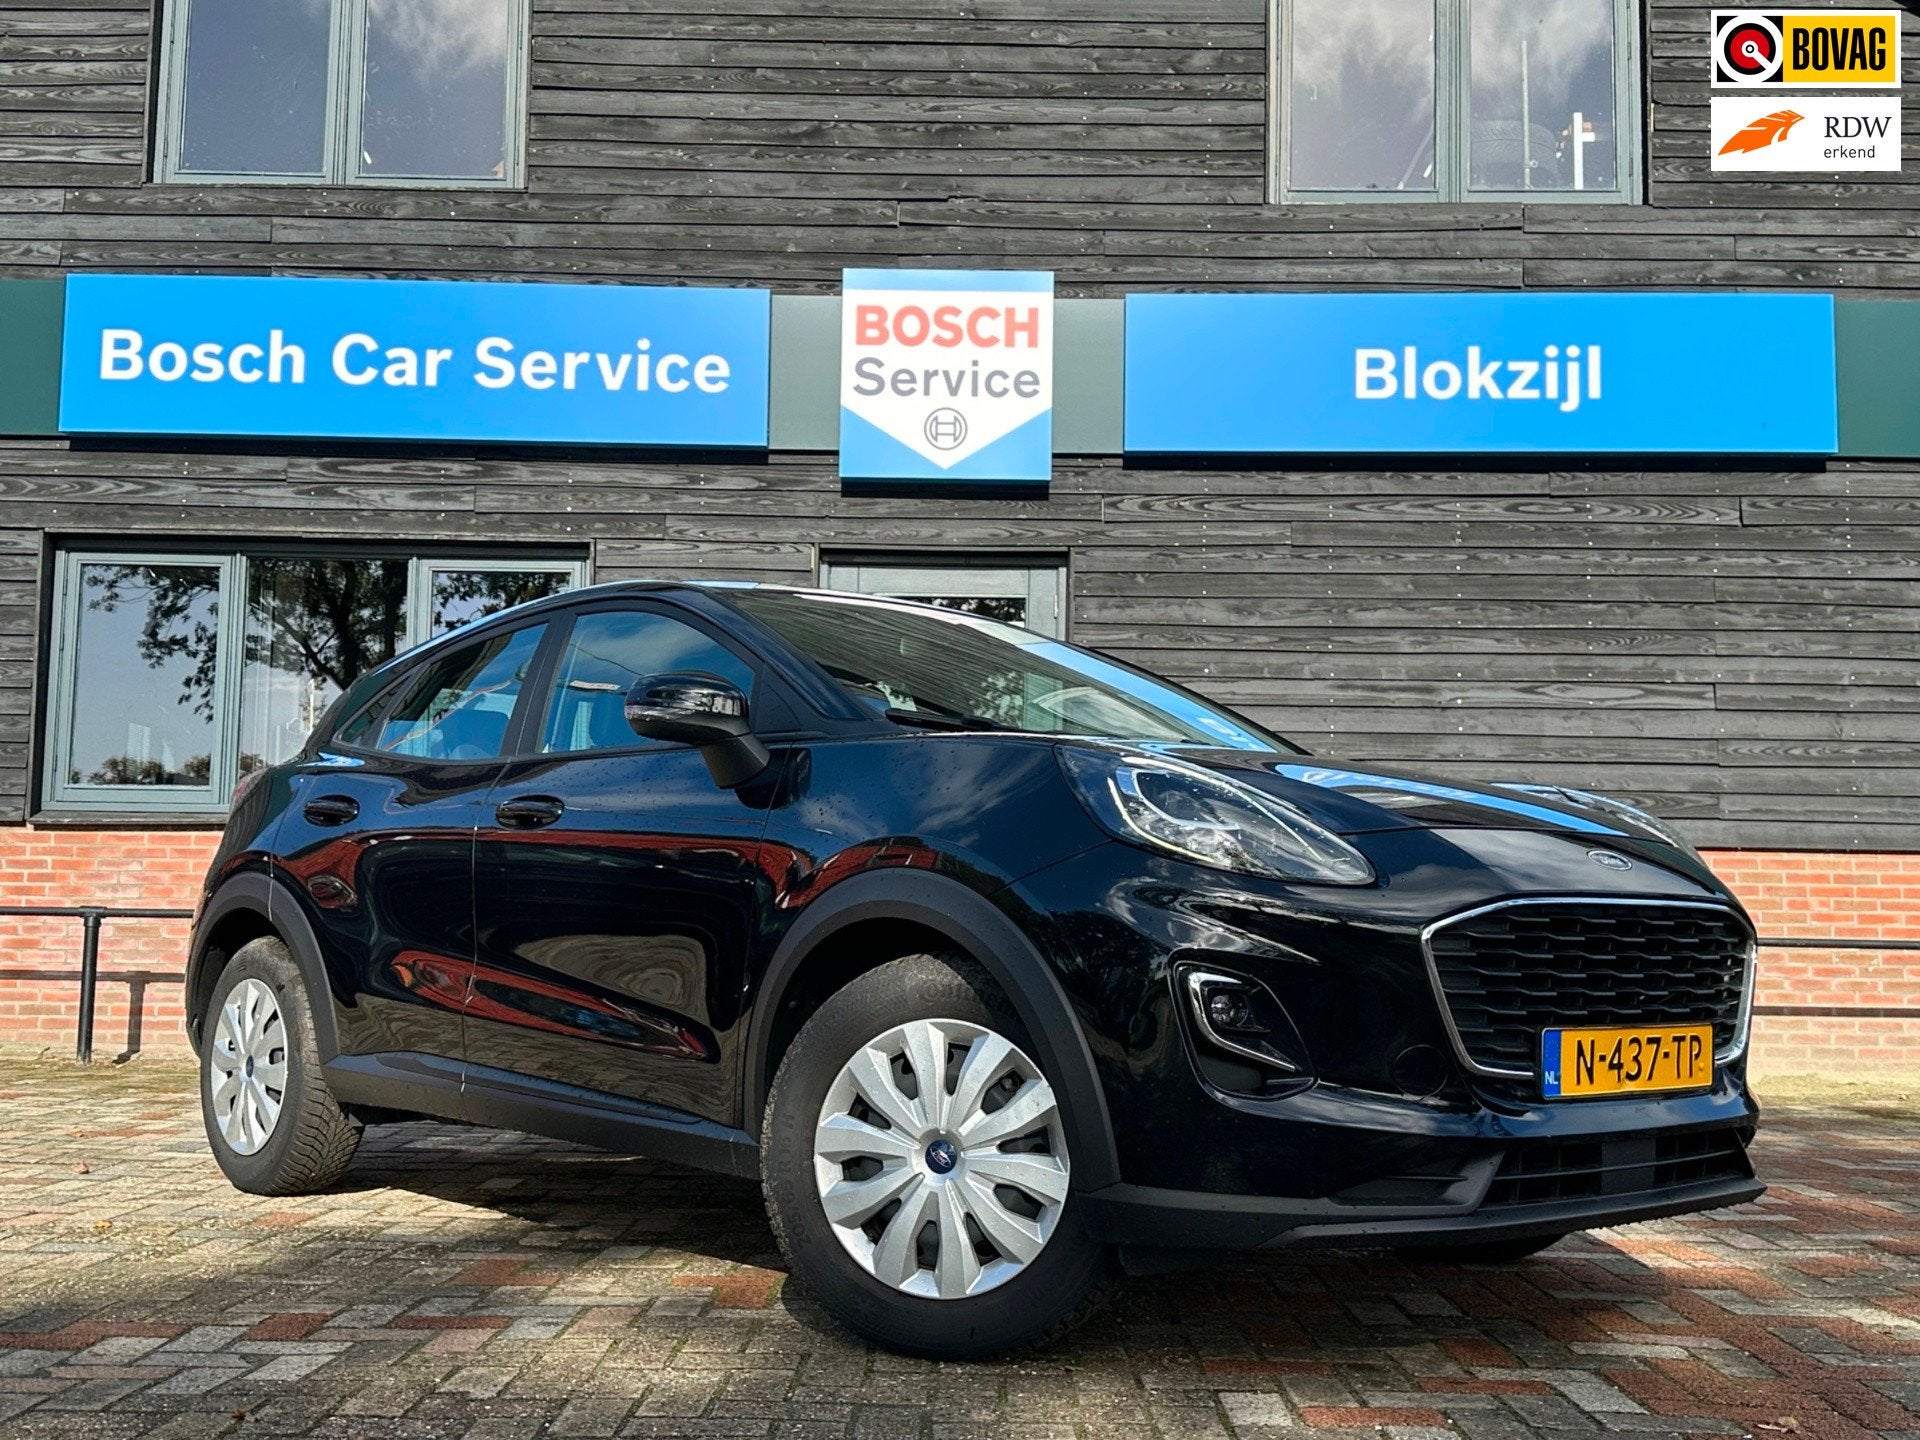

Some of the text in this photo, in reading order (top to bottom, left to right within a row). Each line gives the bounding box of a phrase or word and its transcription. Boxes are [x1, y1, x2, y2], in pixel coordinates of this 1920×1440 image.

[855, 304, 1039, 349] BOSCH
[100, 328, 731, 394] Bosch Car Service
[853, 356, 1040, 399] Service
[1355, 345, 1602, 412] Blokzijl
[1545, 1071, 1558, 1085] NL
[1575, 1034, 1702, 1086] N-437-TP
